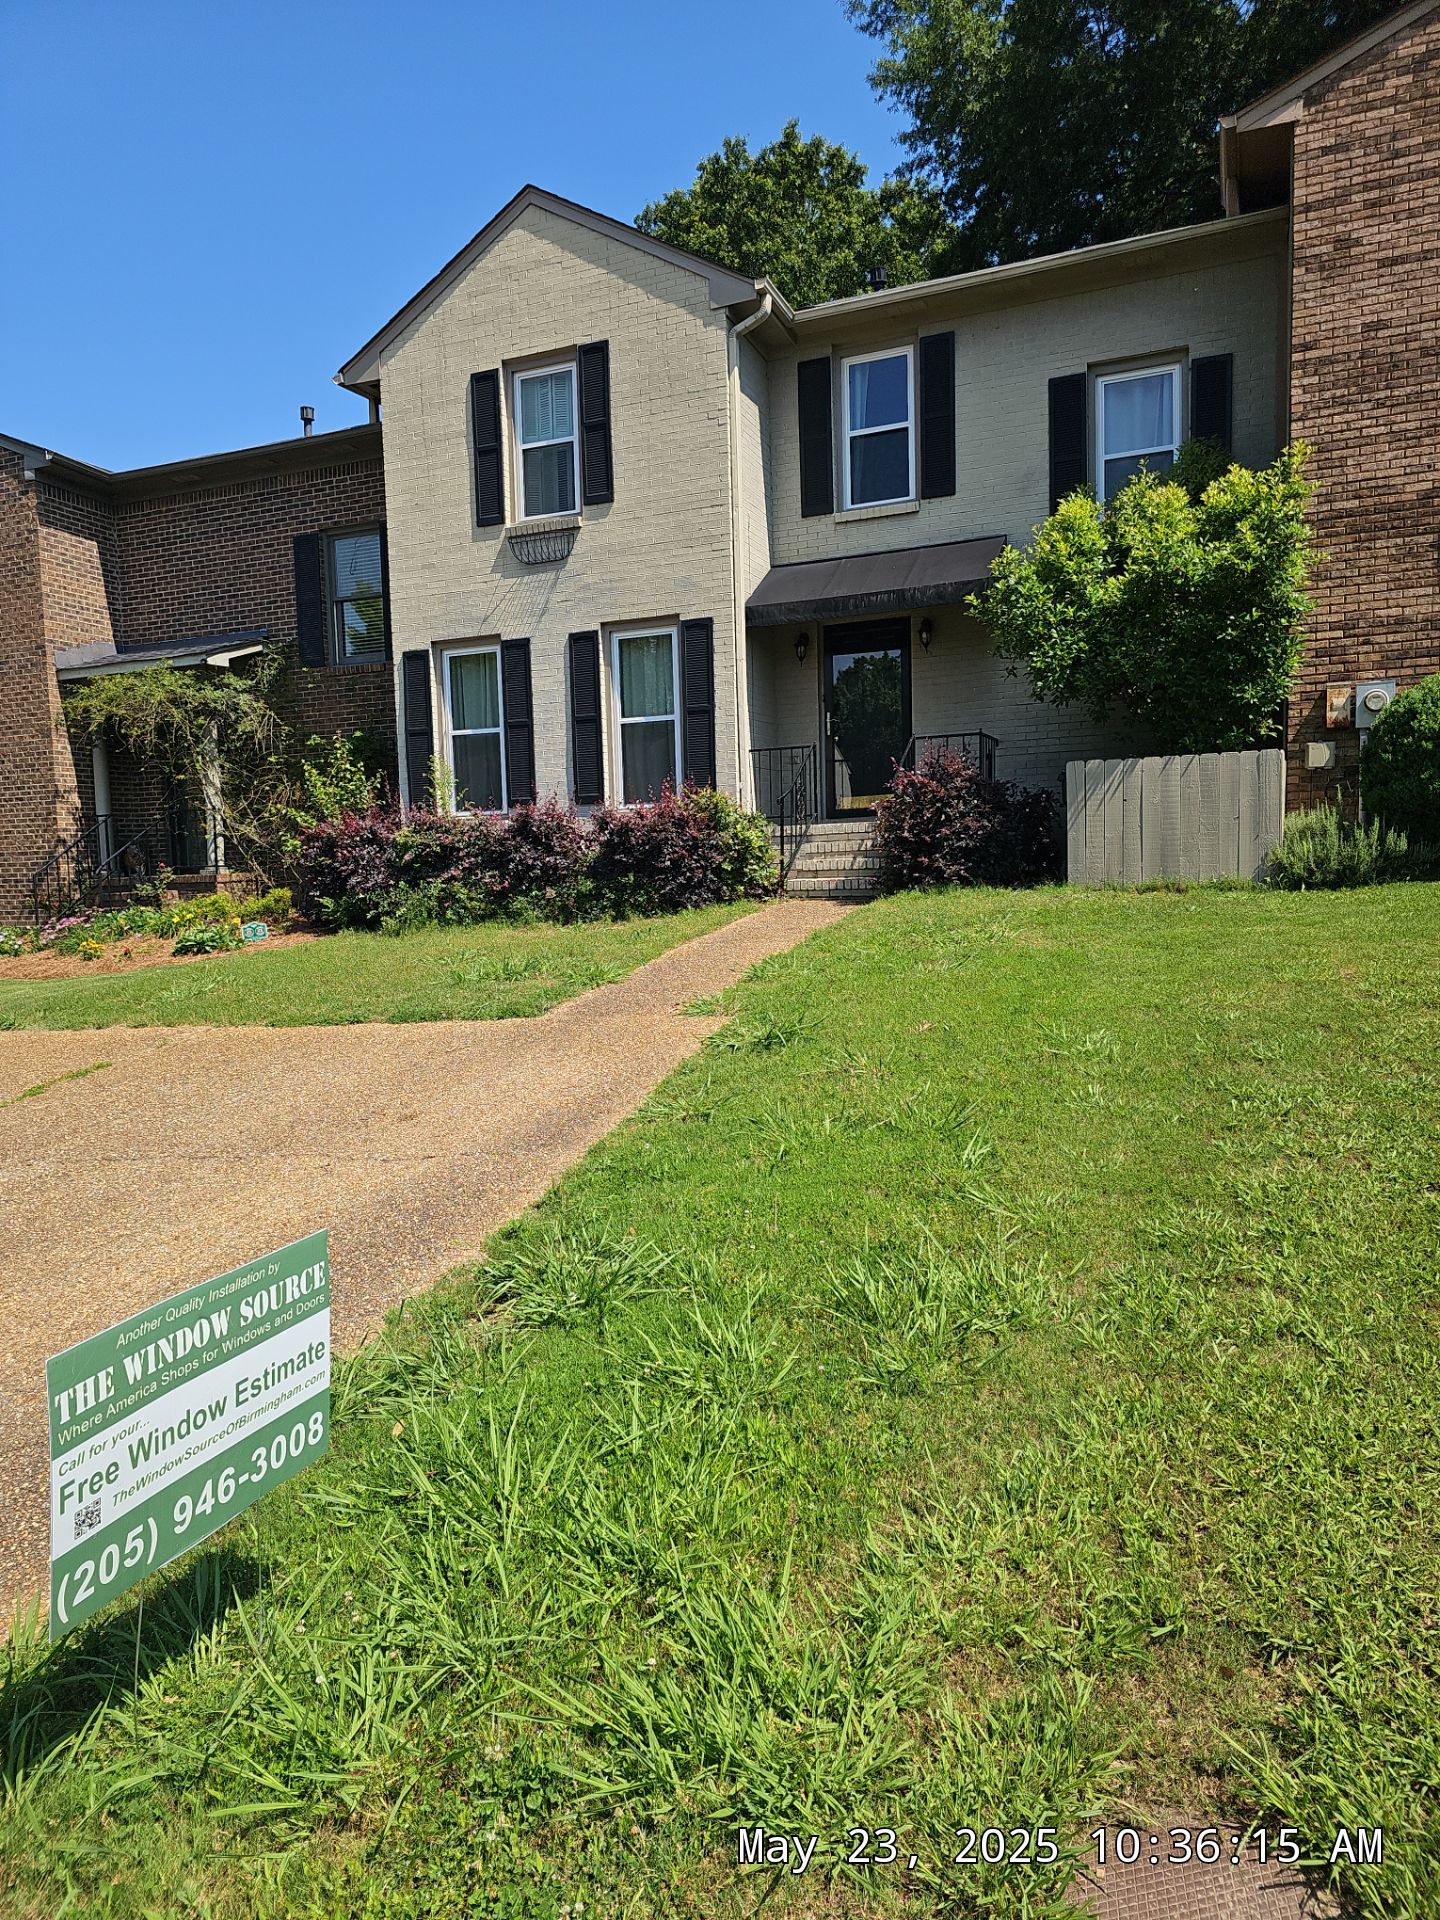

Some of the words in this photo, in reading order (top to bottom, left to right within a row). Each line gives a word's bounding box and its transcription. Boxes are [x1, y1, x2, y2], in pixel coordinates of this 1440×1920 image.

[54, 1365, 115, 1425] THE
[123, 1306, 232, 1386] WINDOW
[240, 1261, 326, 1328] SOURCE
[58, 1412, 103, 1446] Where
[106, 1382, 157, 1419] America
[161, 1360, 200, 1386] Shops
[202, 1349, 218, 1365] for
[221, 1321, 271, 1354] Windows
[274, 1310, 293, 1327] and
[296, 1293, 325, 1316] Doors
[116, 1317, 162, 1349] Another
[166, 1296, 205, 1322] Quality
[209, 1270, 266, 1302] Installation
[268, 1261, 280, 1276] by
[59, 1462, 120, 1516] Free
[128, 1395, 228, 1470] Window
[235, 1340, 326, 1408] Estimate
[59, 1451, 85, 1477] Call
[88, 1441, 107, 1466] for
[111, 1420, 150, 1449] your...
[112, 1370, 326, 1507] TheWindowSourceOfBirmingham.com
[57, 1517, 158, 1624] (205)
[173, 1411, 324, 1535] 946-3008
